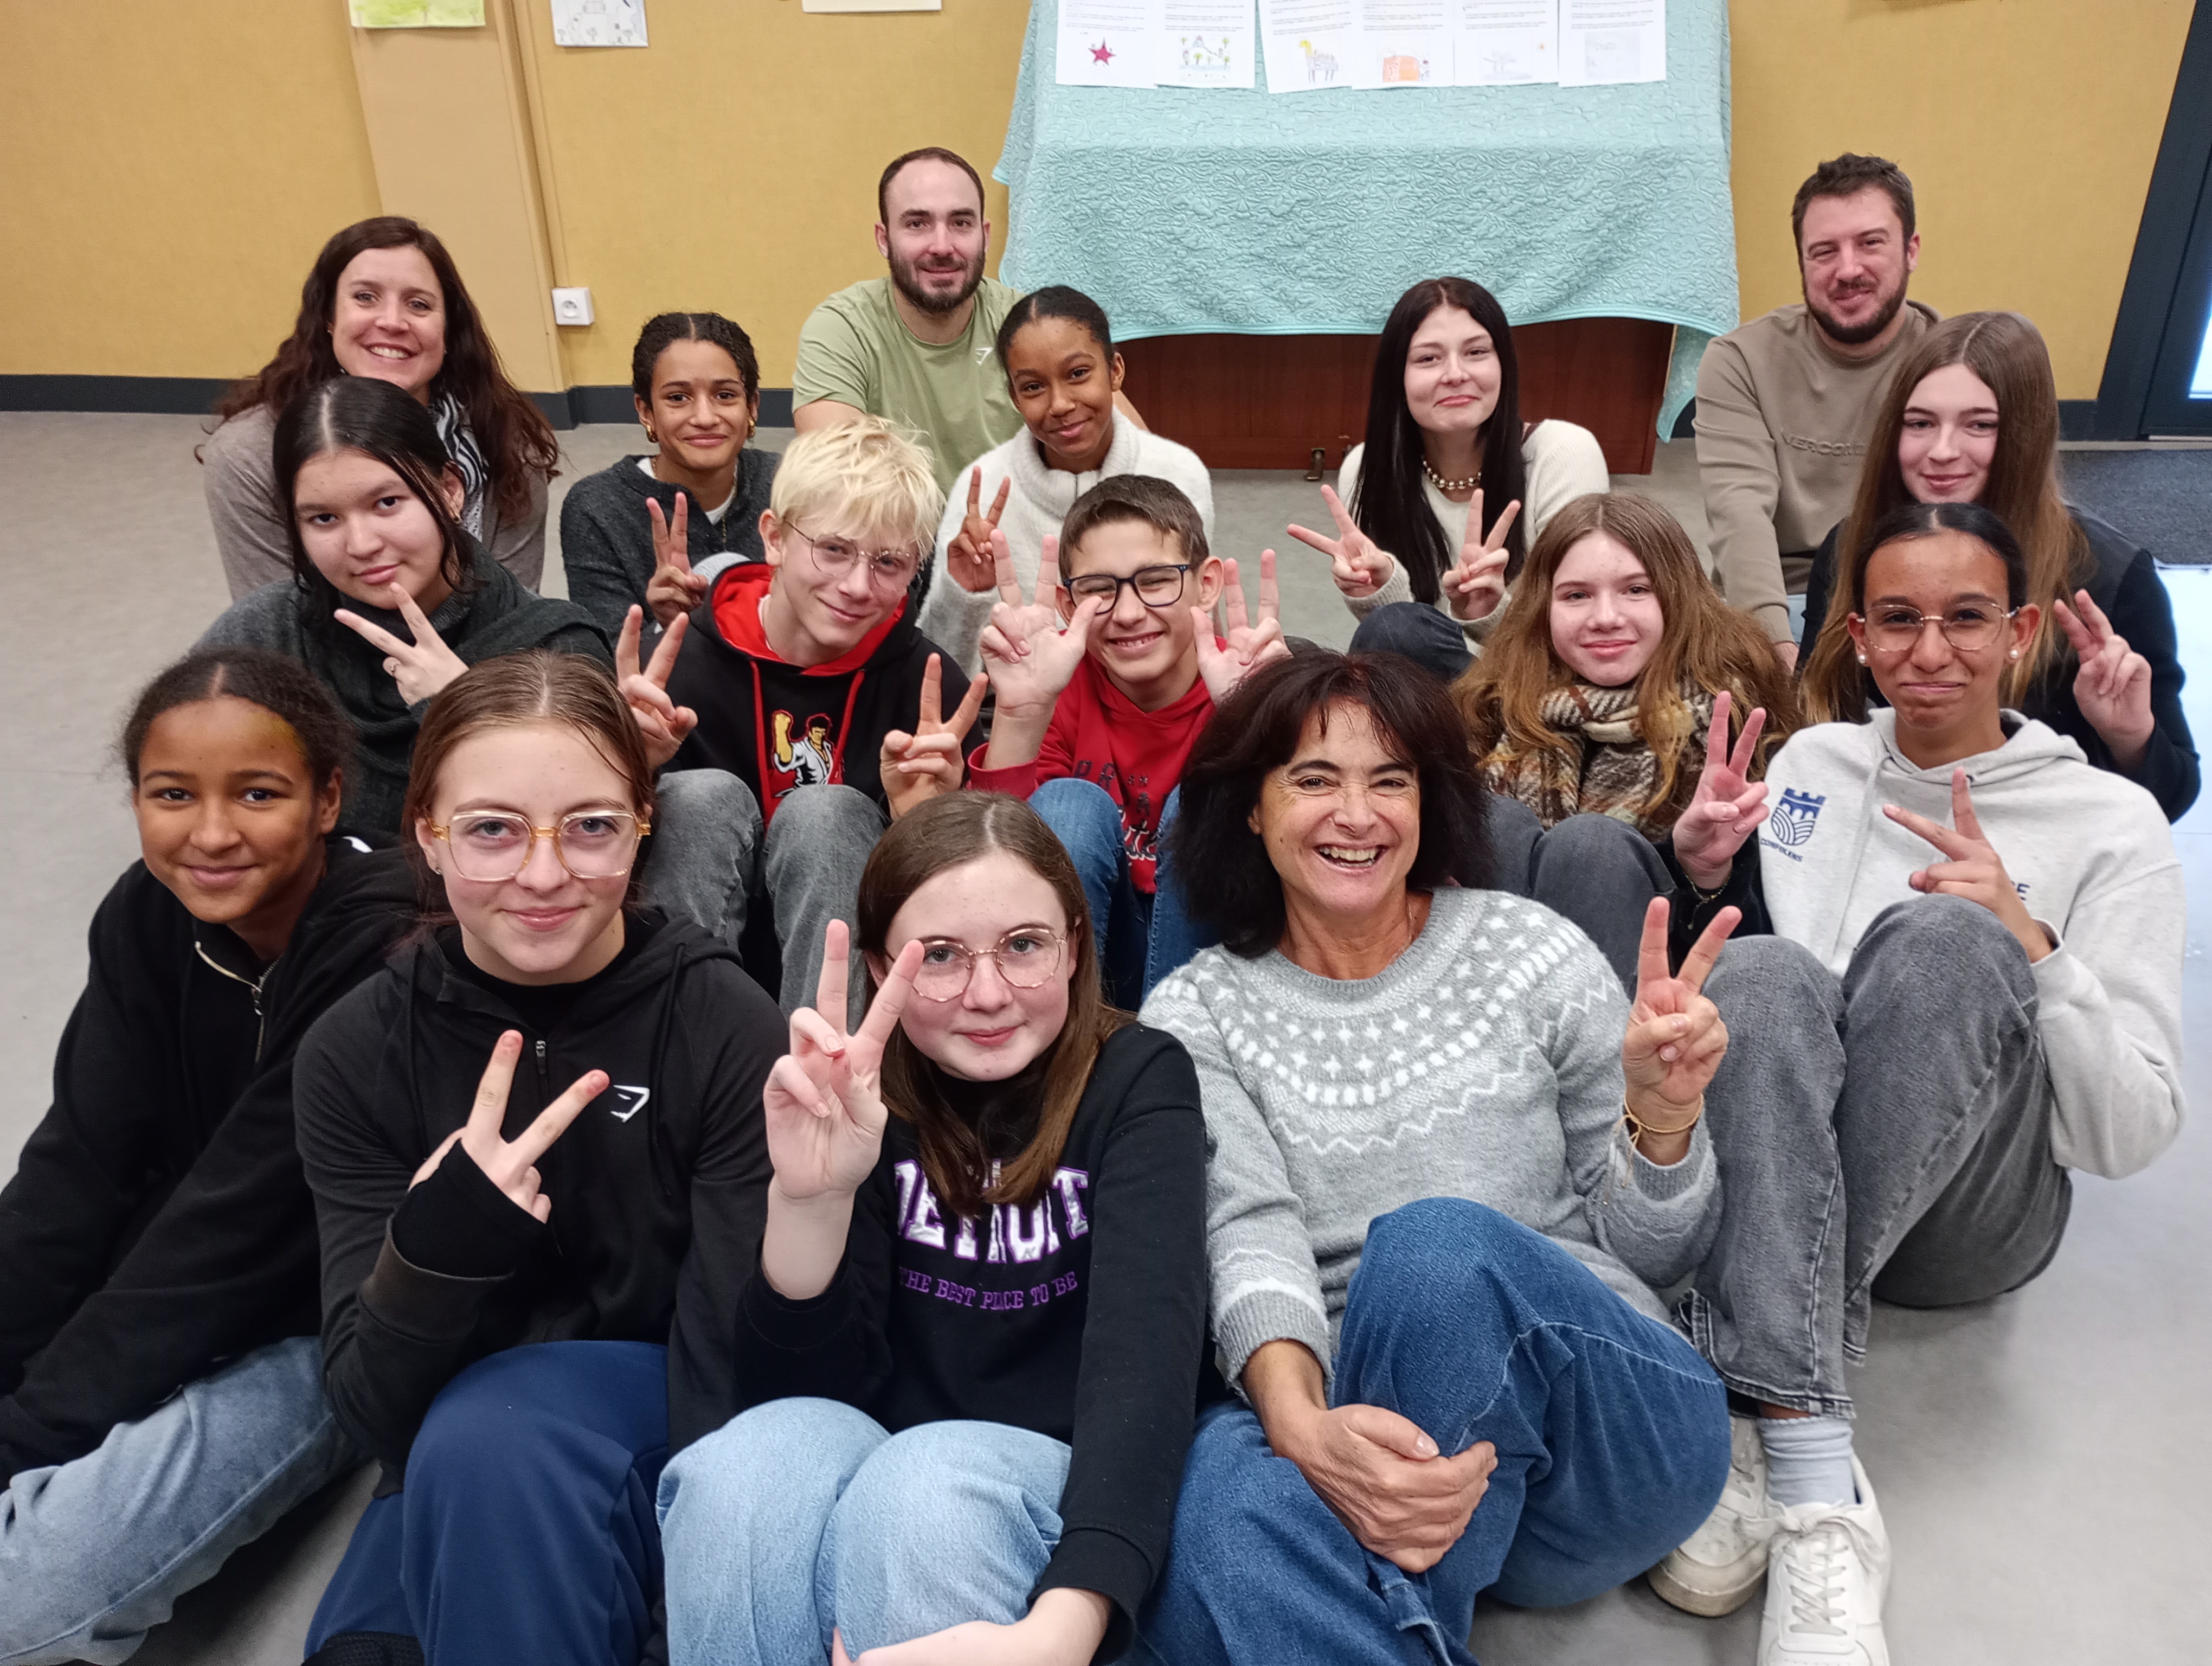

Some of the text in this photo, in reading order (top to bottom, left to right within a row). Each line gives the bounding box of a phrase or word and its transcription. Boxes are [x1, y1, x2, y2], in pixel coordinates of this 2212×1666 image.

[934, 1278, 976, 1308] BEST
[1030, 1283, 1050, 1306] TO
[1051, 1271, 1078, 1297] BE
